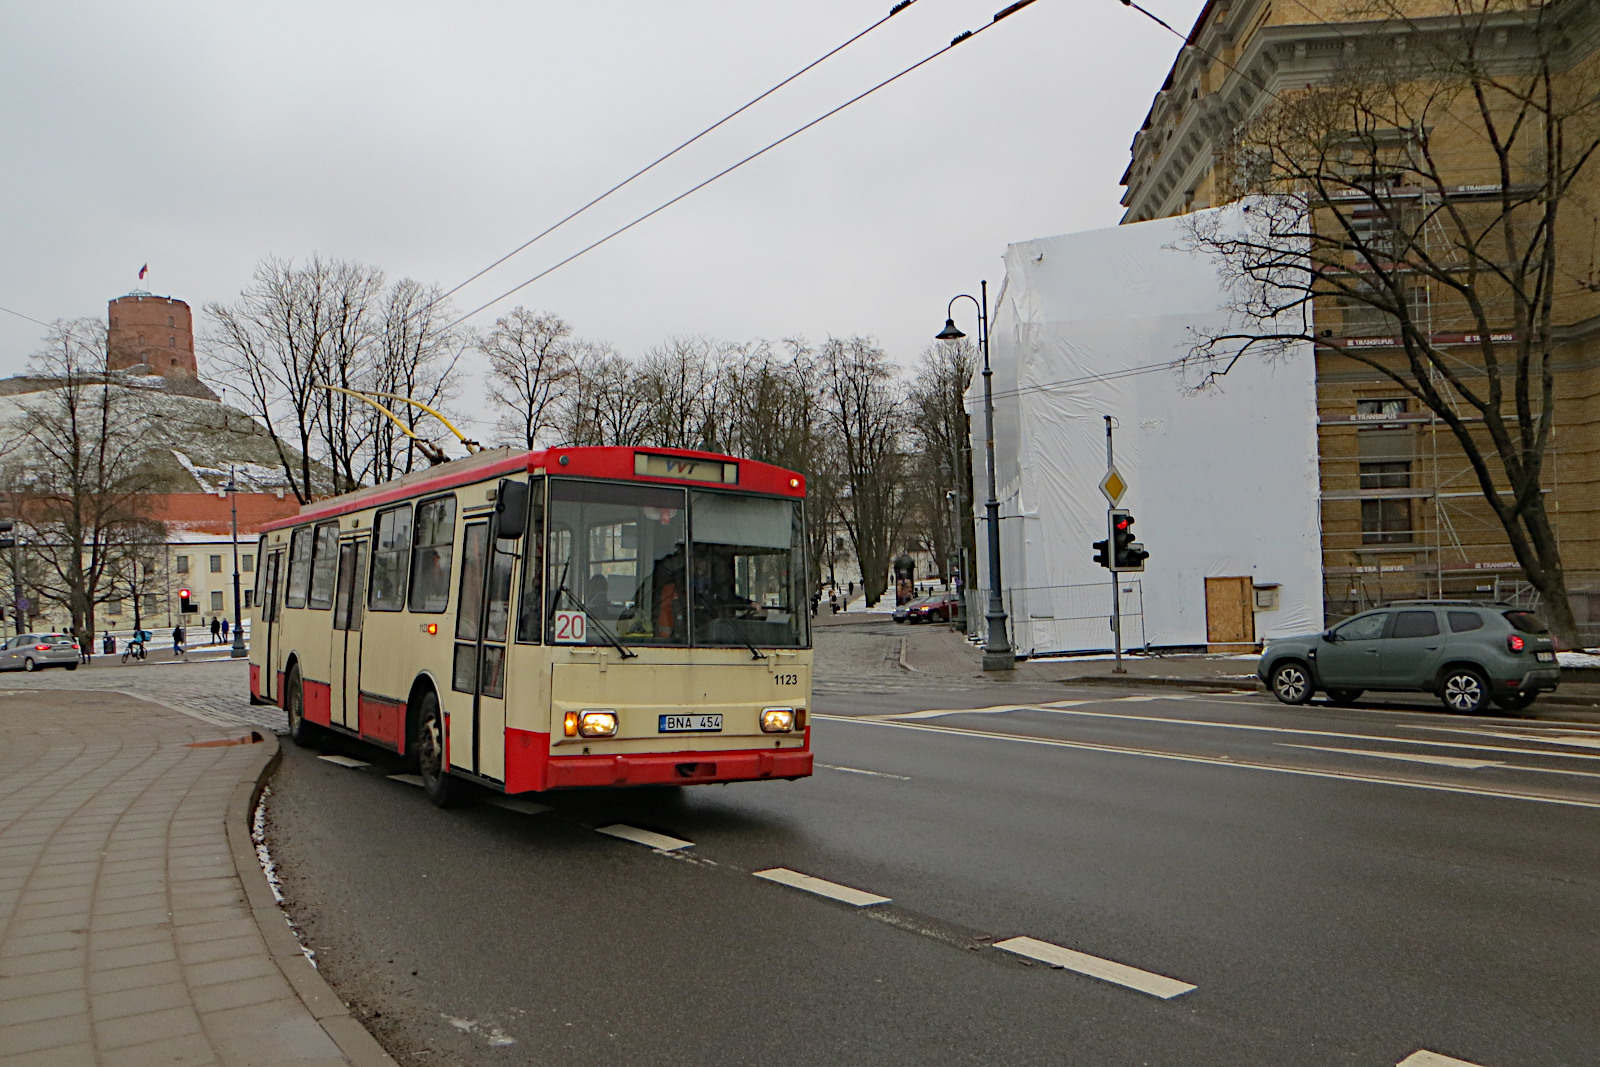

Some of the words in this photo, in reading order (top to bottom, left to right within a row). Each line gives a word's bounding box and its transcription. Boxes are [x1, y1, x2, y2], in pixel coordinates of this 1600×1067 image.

[1358, 413, 1397, 421] TRANSRIFUS
[667, 459, 700, 475] VVT
[557, 614, 585, 639] 20
[774, 674, 798, 685] 1123
[667, 716, 692, 729] BNA
[700, 716, 720, 728] 454
